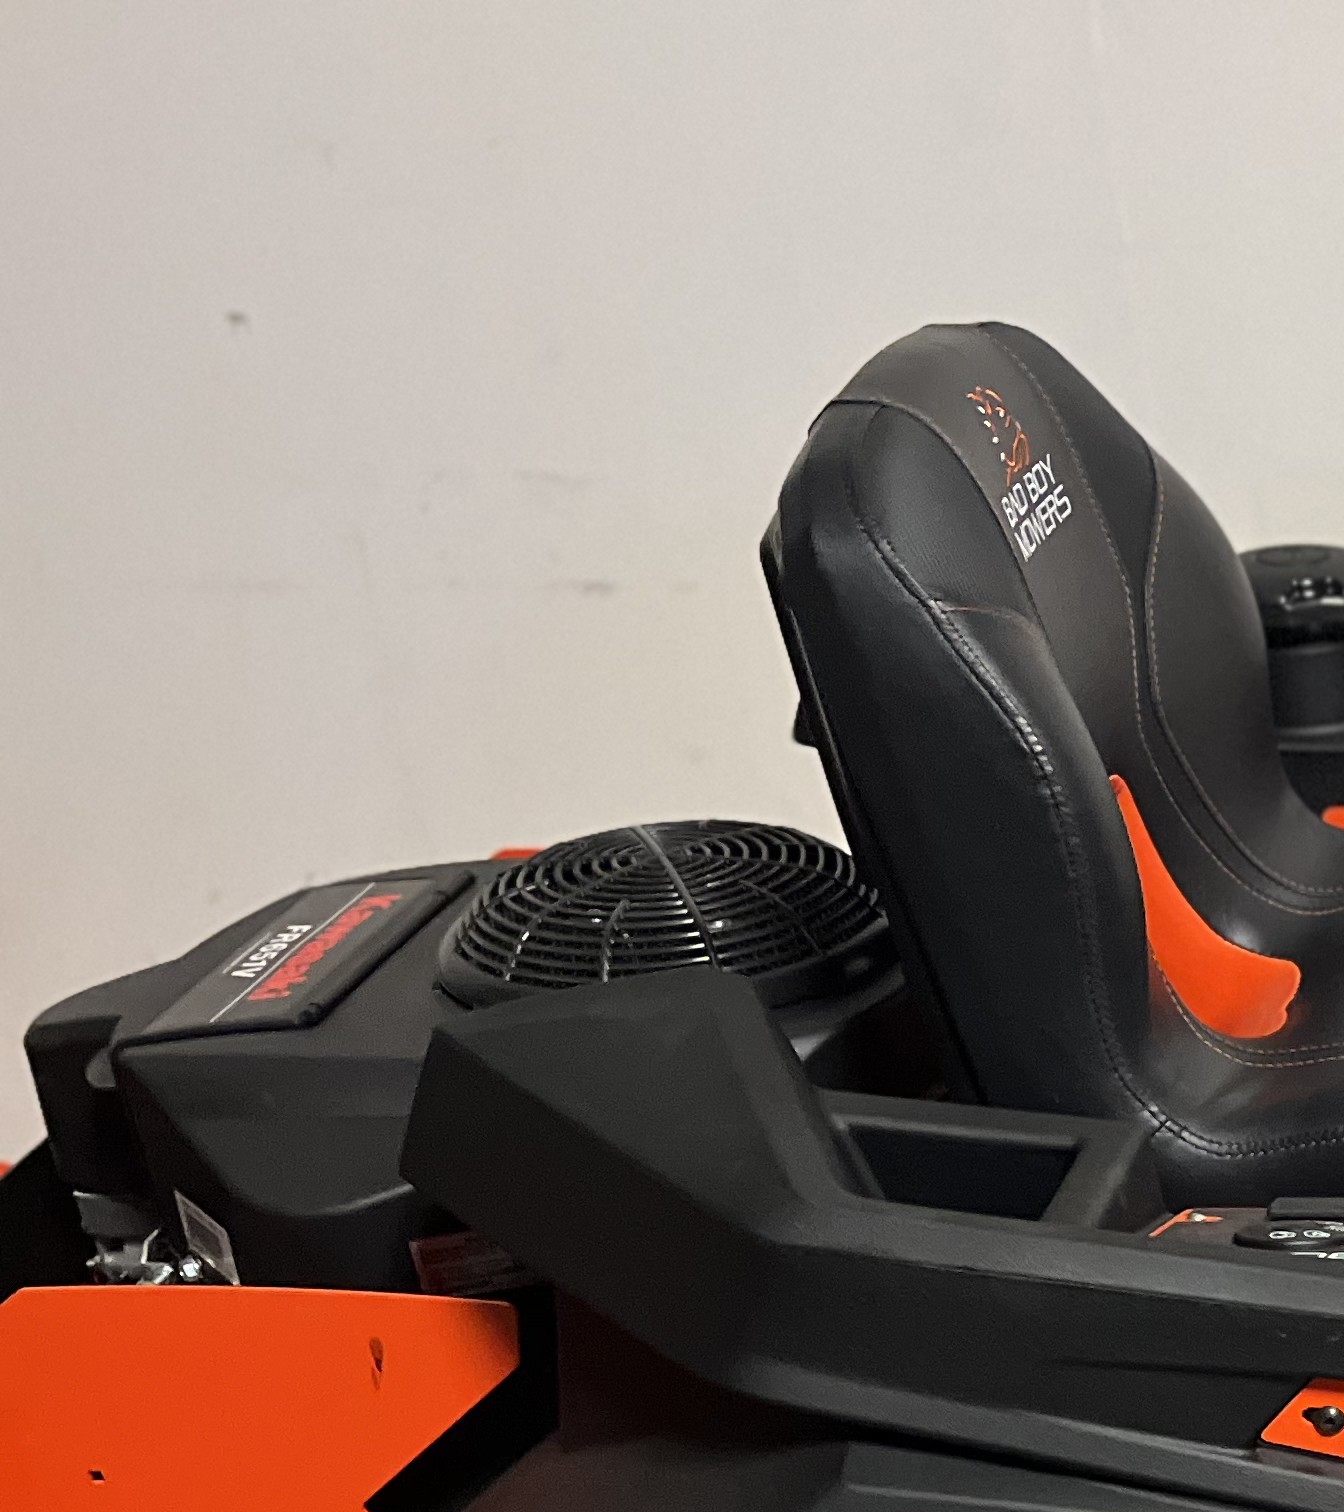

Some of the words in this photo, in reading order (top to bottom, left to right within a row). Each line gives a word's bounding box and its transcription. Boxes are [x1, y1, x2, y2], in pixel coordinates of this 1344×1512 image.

[1001, 482, 1029, 528] BAD
[1023, 453, 1056, 503] BOY
[230, 923, 313, 978] FR651V
